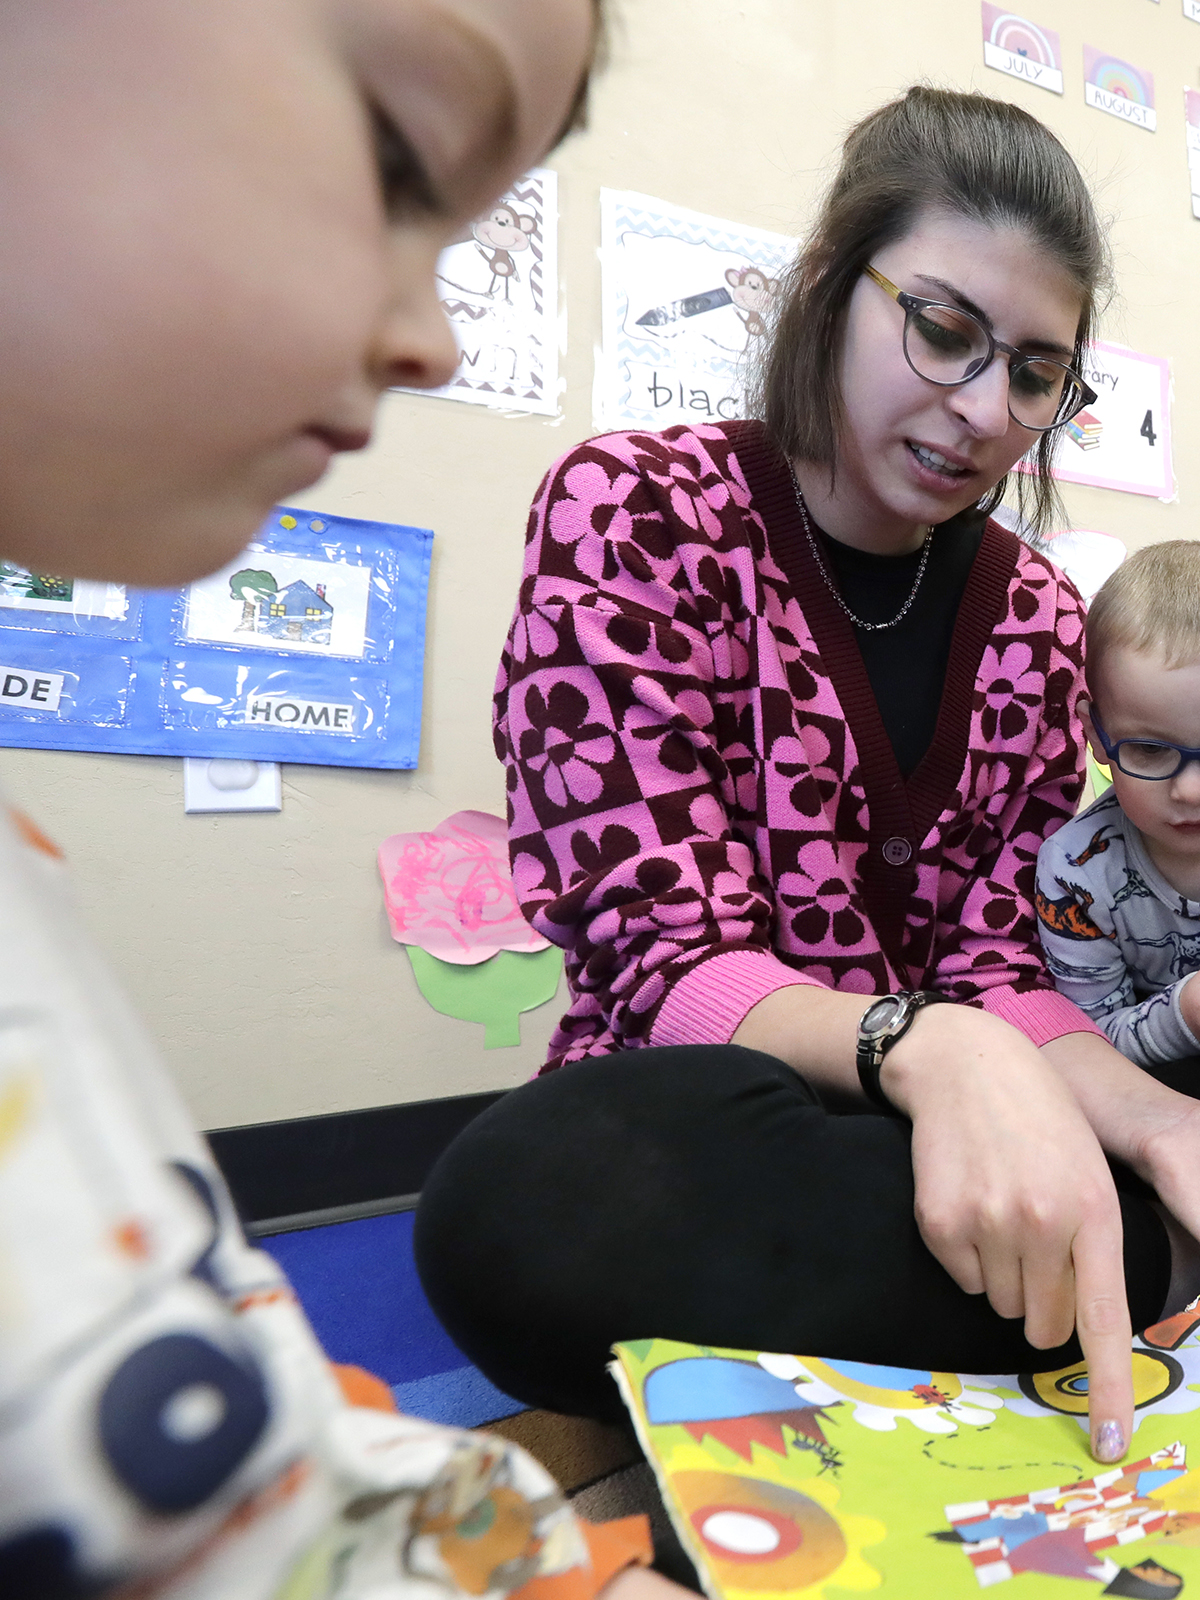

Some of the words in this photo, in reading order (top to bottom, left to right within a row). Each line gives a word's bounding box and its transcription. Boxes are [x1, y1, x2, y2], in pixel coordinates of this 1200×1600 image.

[1003, 56, 1043, 80] JULY
[1094, 90, 1149, 124] AUGUST
[1140, 409, 1157, 447] 4
[1, 674, 51, 703] DE
[251, 701, 349, 729] HOME
